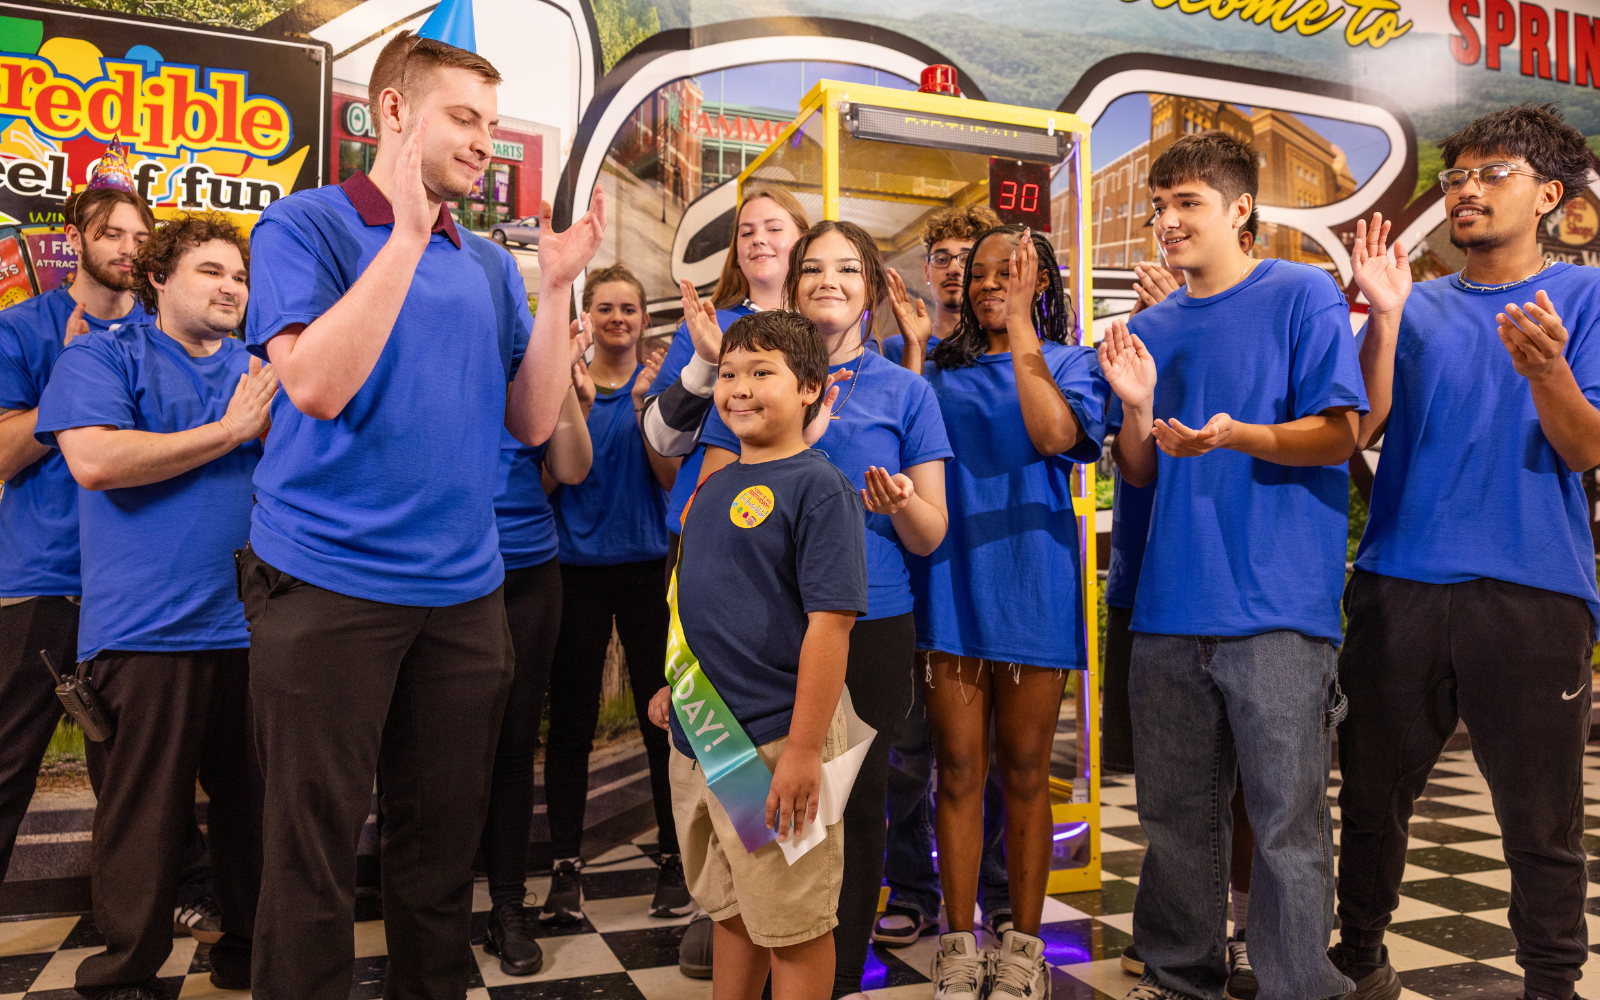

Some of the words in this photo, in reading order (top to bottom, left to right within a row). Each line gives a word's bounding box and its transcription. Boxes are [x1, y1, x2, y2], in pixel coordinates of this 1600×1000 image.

[1344, 0, 1413, 48] to
[1448, 0, 1600, 90] SPRIN
[0, 152, 69, 197] el
[180, 163, 282, 212] fun
[999, 180, 1039, 212] 30
[39, 240, 46, 254] 1
[51, 240, 78, 256] FR
